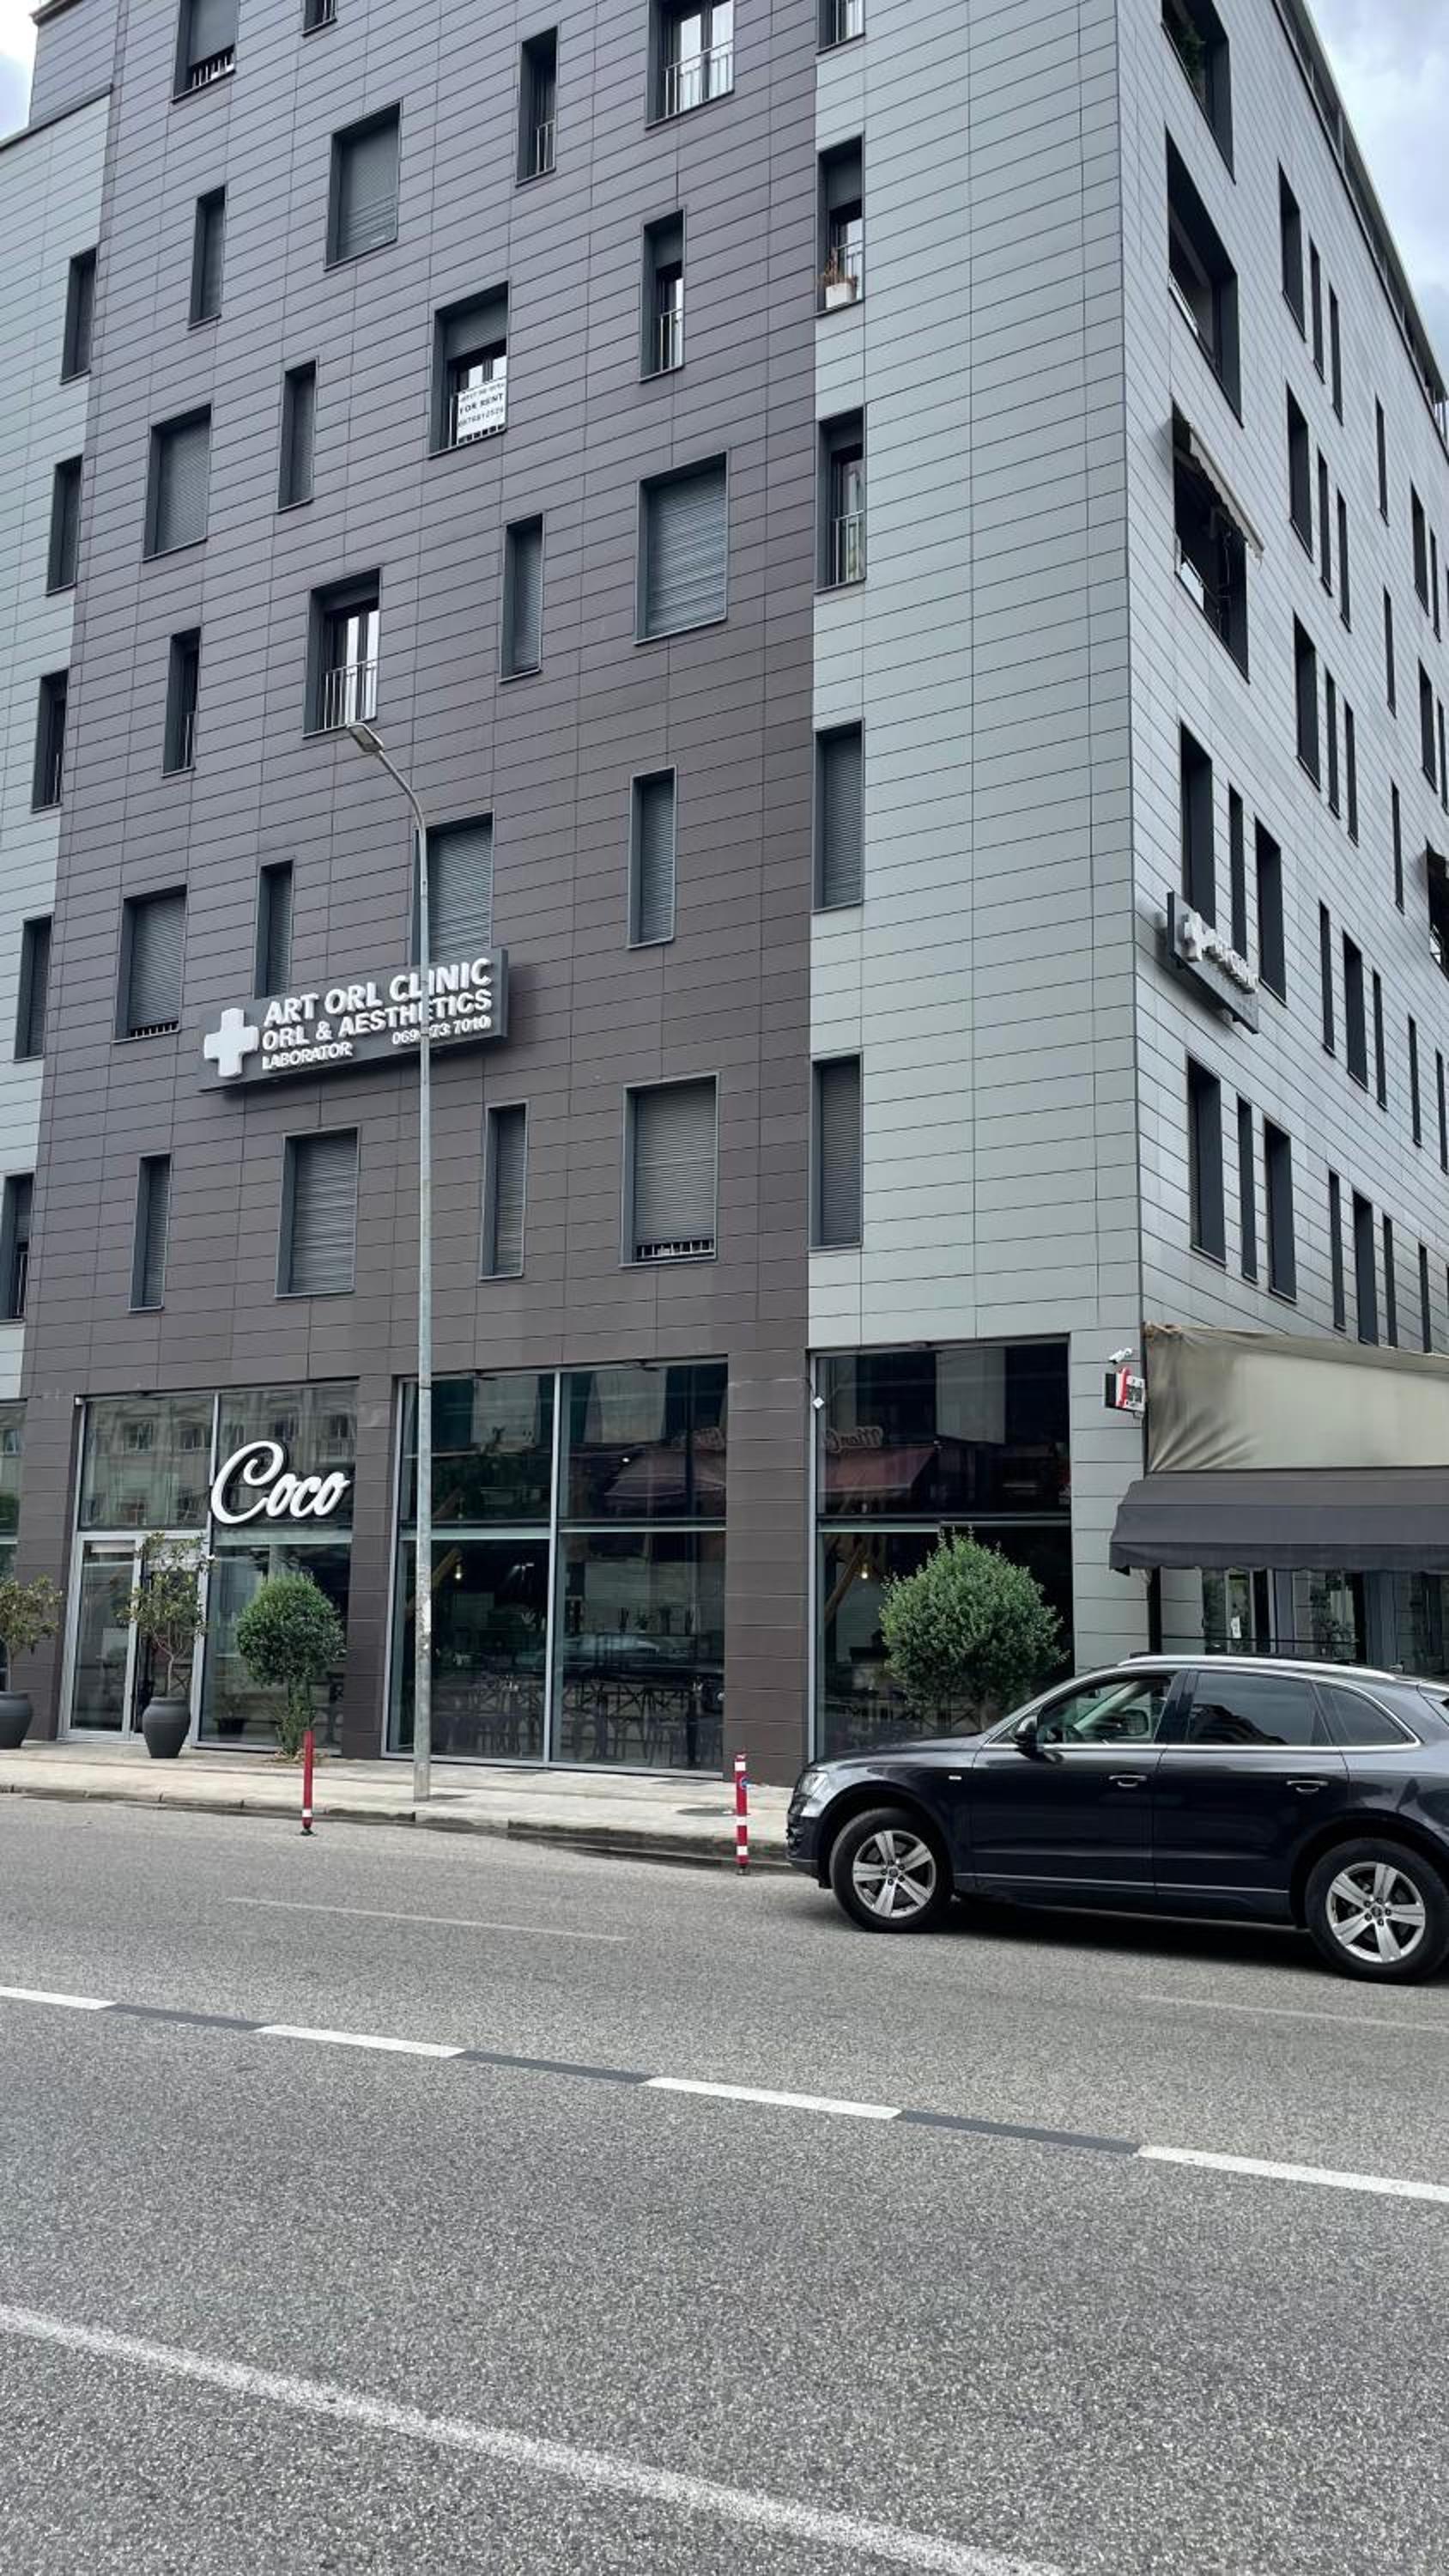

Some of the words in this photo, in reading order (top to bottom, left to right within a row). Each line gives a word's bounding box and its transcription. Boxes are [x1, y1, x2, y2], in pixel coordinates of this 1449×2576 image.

[459, 403, 476, 414] FOR
[481, 392, 503, 406] RENT
[264, 992, 319, 1028] ART
[324, 981, 384, 1015] ORL
[390, 957, 492, 1002] CLINIC
[263, 1025, 311, 1051] ORL
[315, 1020, 333, 1041] &
[392, 1029, 420, 1045] 069
[424, 1022, 451, 1040] 73
[453, 1015, 492, 1035] 7010
[262, 1042, 354, 1070] LABORATOR
[211, 1440, 350, 1524] Coco
